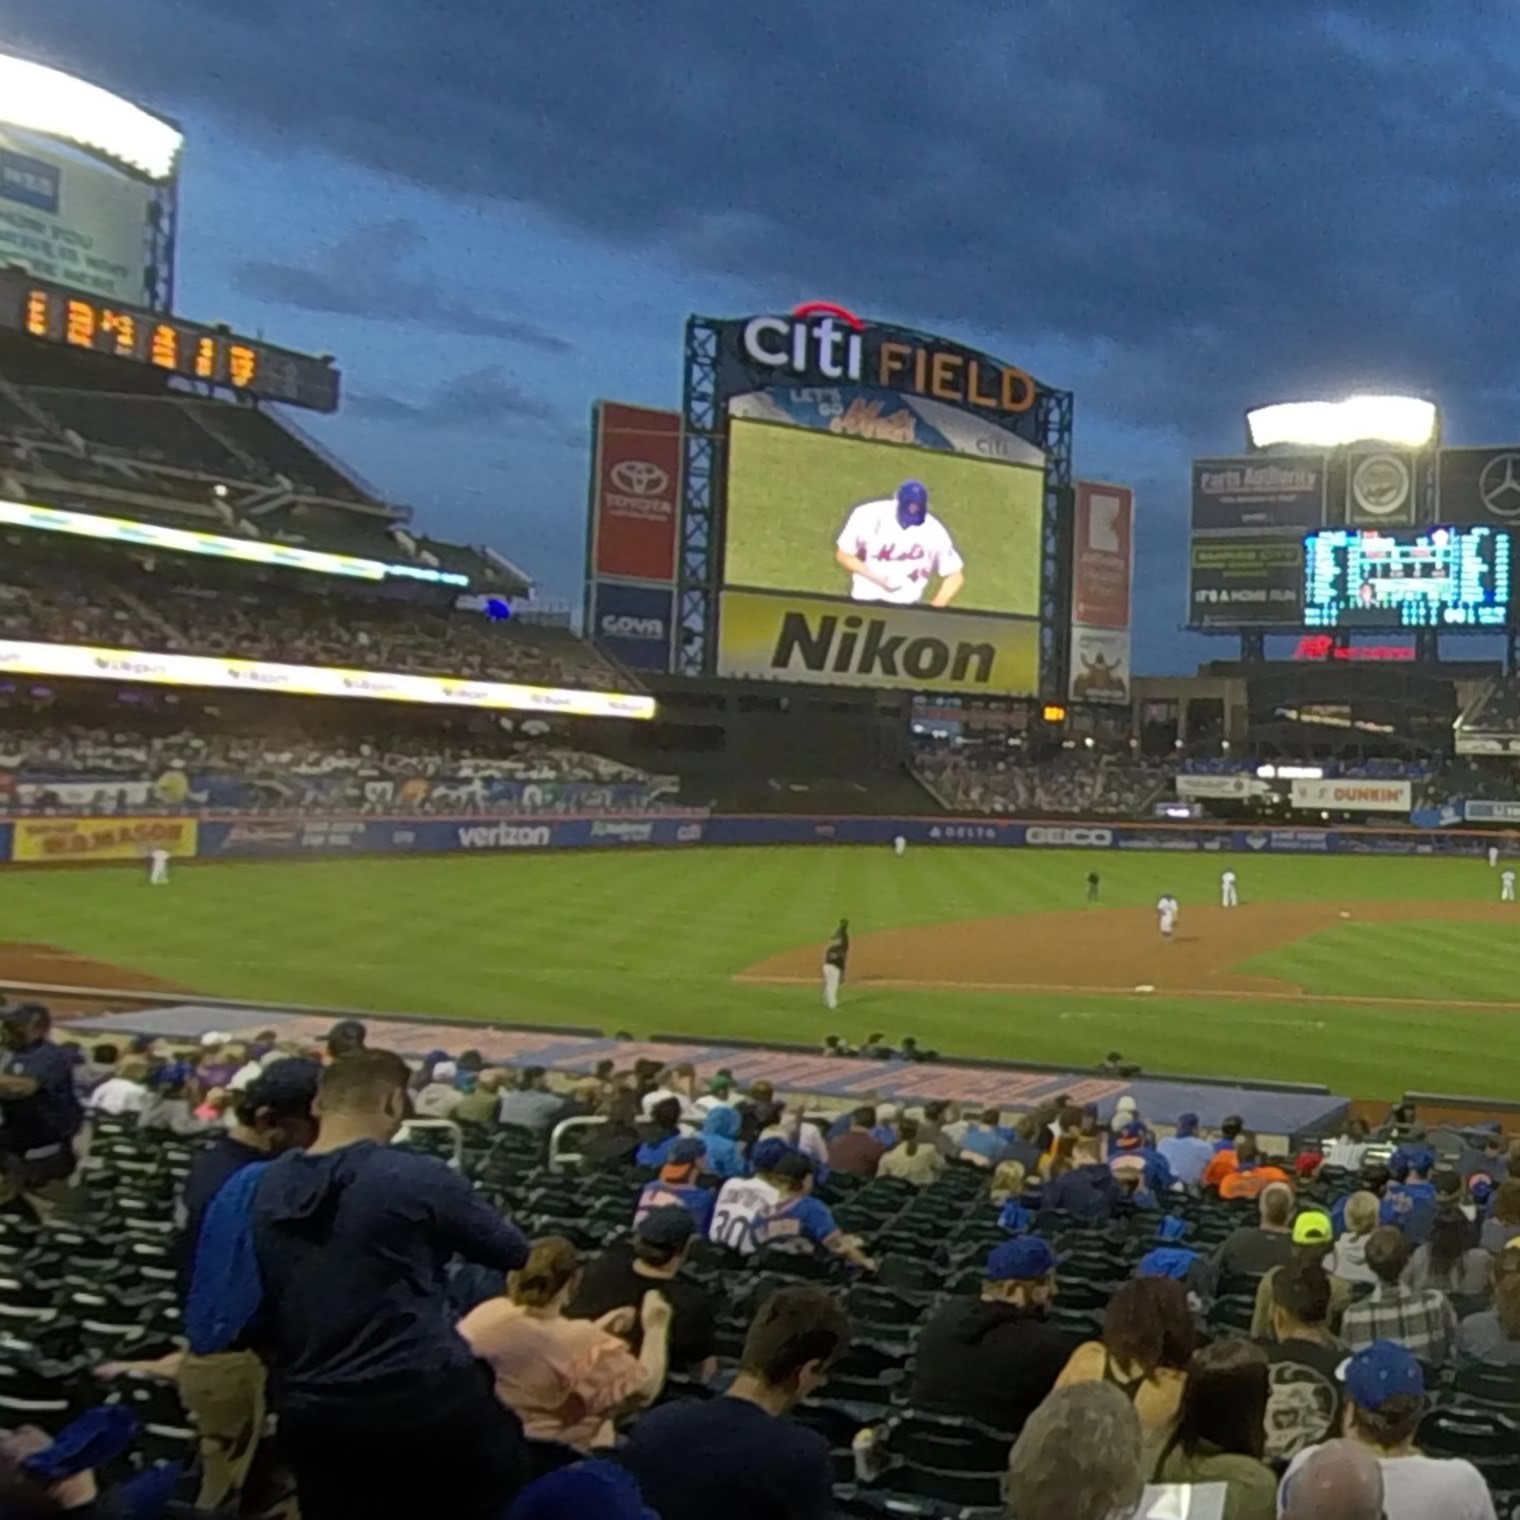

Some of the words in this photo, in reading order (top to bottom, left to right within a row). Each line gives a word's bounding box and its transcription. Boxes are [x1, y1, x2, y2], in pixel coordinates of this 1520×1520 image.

[879, 342, 1036, 413] FIELD
[819, 402, 844, 416] GO
[605, 493, 672, 514] TOYOTA
[1219, 590, 1230, 602] A
[601, 615, 664, 635] GOYA
[770, 611, 998, 683] Nikon
[1333, 787, 1404, 803] DUNKIN'
[458, 823, 550, 847] verizon
[945, 826, 996, 839] DELTA
[1025, 827, 1113, 846] GEICO
